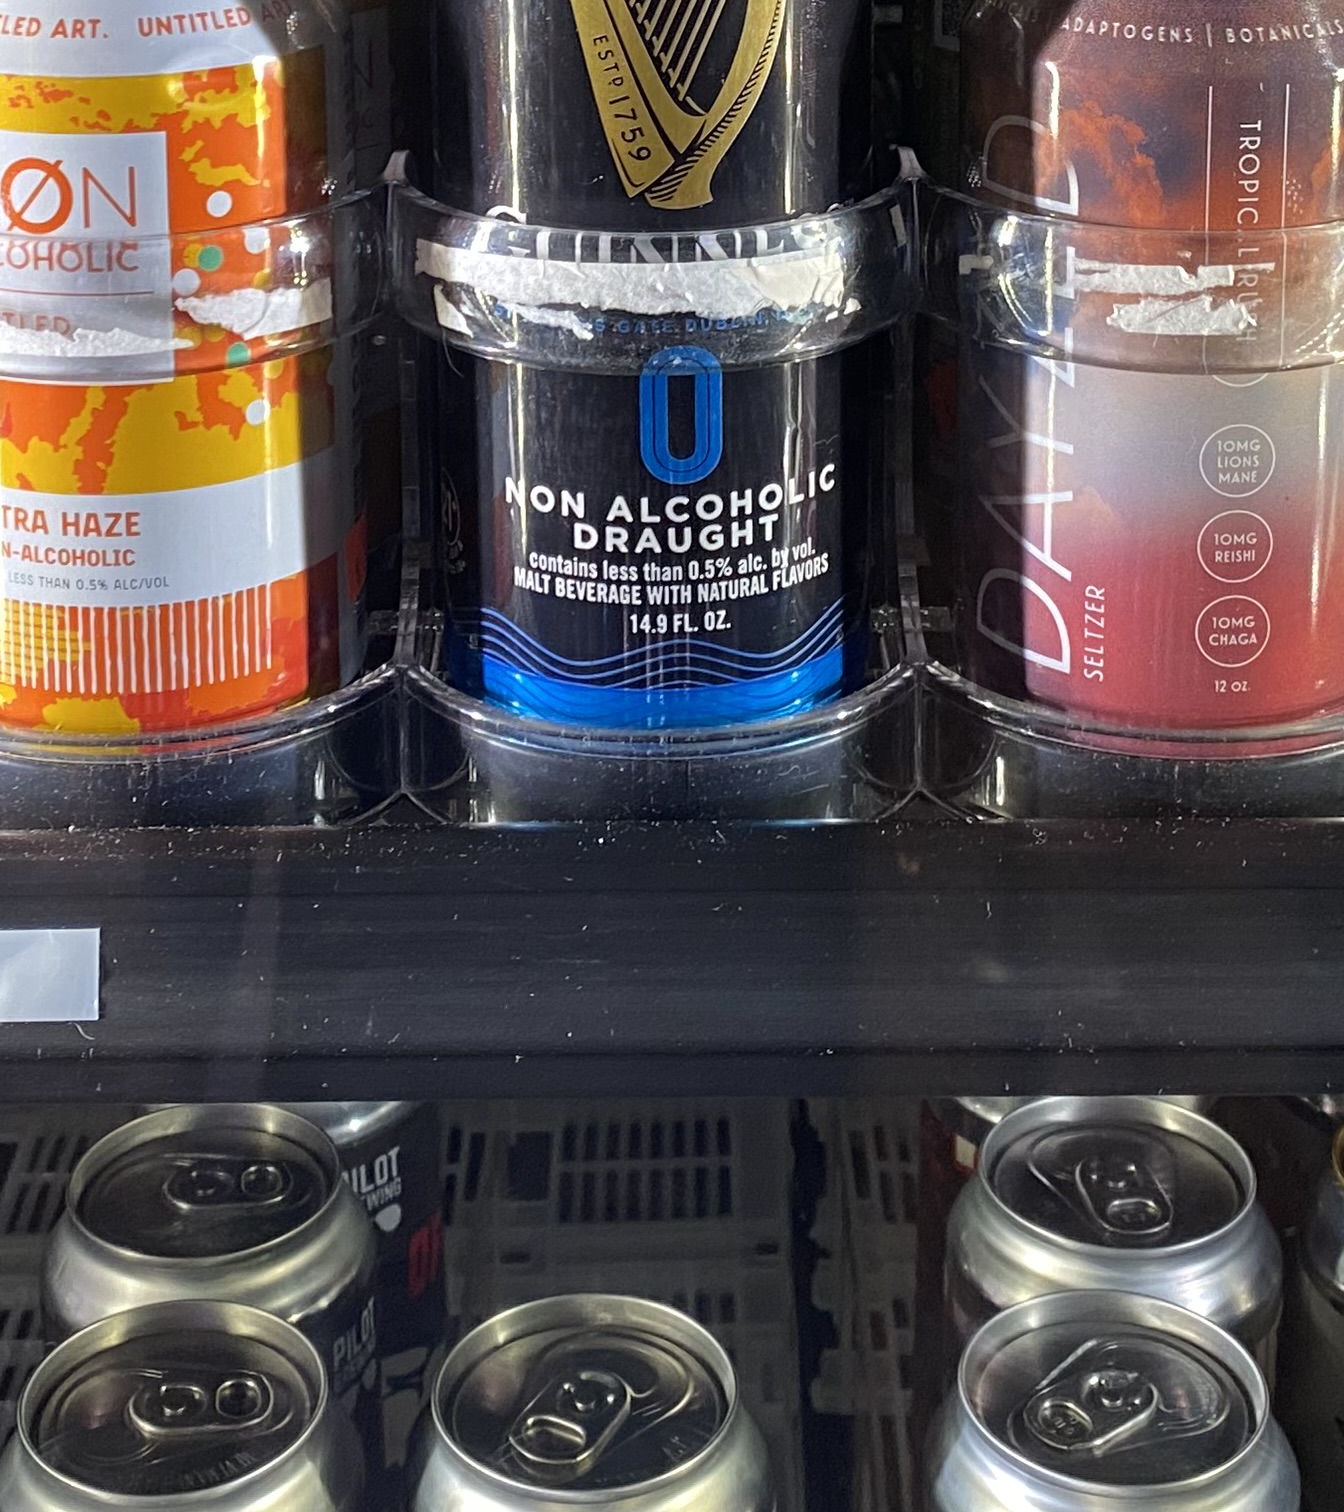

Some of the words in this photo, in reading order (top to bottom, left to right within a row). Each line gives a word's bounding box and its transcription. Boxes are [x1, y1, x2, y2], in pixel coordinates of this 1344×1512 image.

[50, 18, 110, 39] ART.
[137, 5, 252, 38] UNTITLED
[1060, 15, 1194, 45] ADAPTOGENS
[1236, 119, 1263, 258] TROPICL
[639, 345, 724, 485] 0
[1216, 438, 1262, 453] 10MG
[1216, 455, 1260, 469] LIONS
[1218, 470, 1258, 484] MANE
[504, 475, 586, 519] NON
[605, 463, 837, 523] ALCOHOLIC
[61, 511, 142, 537] HAZE
[572, 513, 780, 555] DRAUGHT
[1213, 531, 1258, 546] 10MG
[528, 550, 598, 581] contains
[602, 559, 639, 583] less
[642, 559, 684, 583] than
[687, 555, 734, 582] 0.5%
[737, 551, 768, 575] alc.
[772, 545, 789, 571] by
[791, 536, 817, 562] vol.
[1214, 549, 1257, 563] REISHI
[7, 572, 35, 586] LESS
[39, 575, 71, 590] THAN
[75, 578, 109, 591] 0.5%
[113, 575, 170, 591] ALC/VOL
[513, 566, 551, 597] MALT
[554, 578, 642, 607] BEVERAGE
[646, 584, 693, 606] WITH
[697, 578, 770, 605] NATURAL
[771, 552, 830, 592] FLAVORS
[629, 613, 669, 635] 14.9
[672, 612, 699, 634] FL.
[703, 609, 732, 631] OZ.
[1083, 584, 1106, 682] SELTZER
[1211, 615, 1256, 629] 10MG
[1208, 632, 1258, 647] CHAGA
[1214, 680, 1228, 692] 12
[341, 1145, 401, 1194] ILOT
